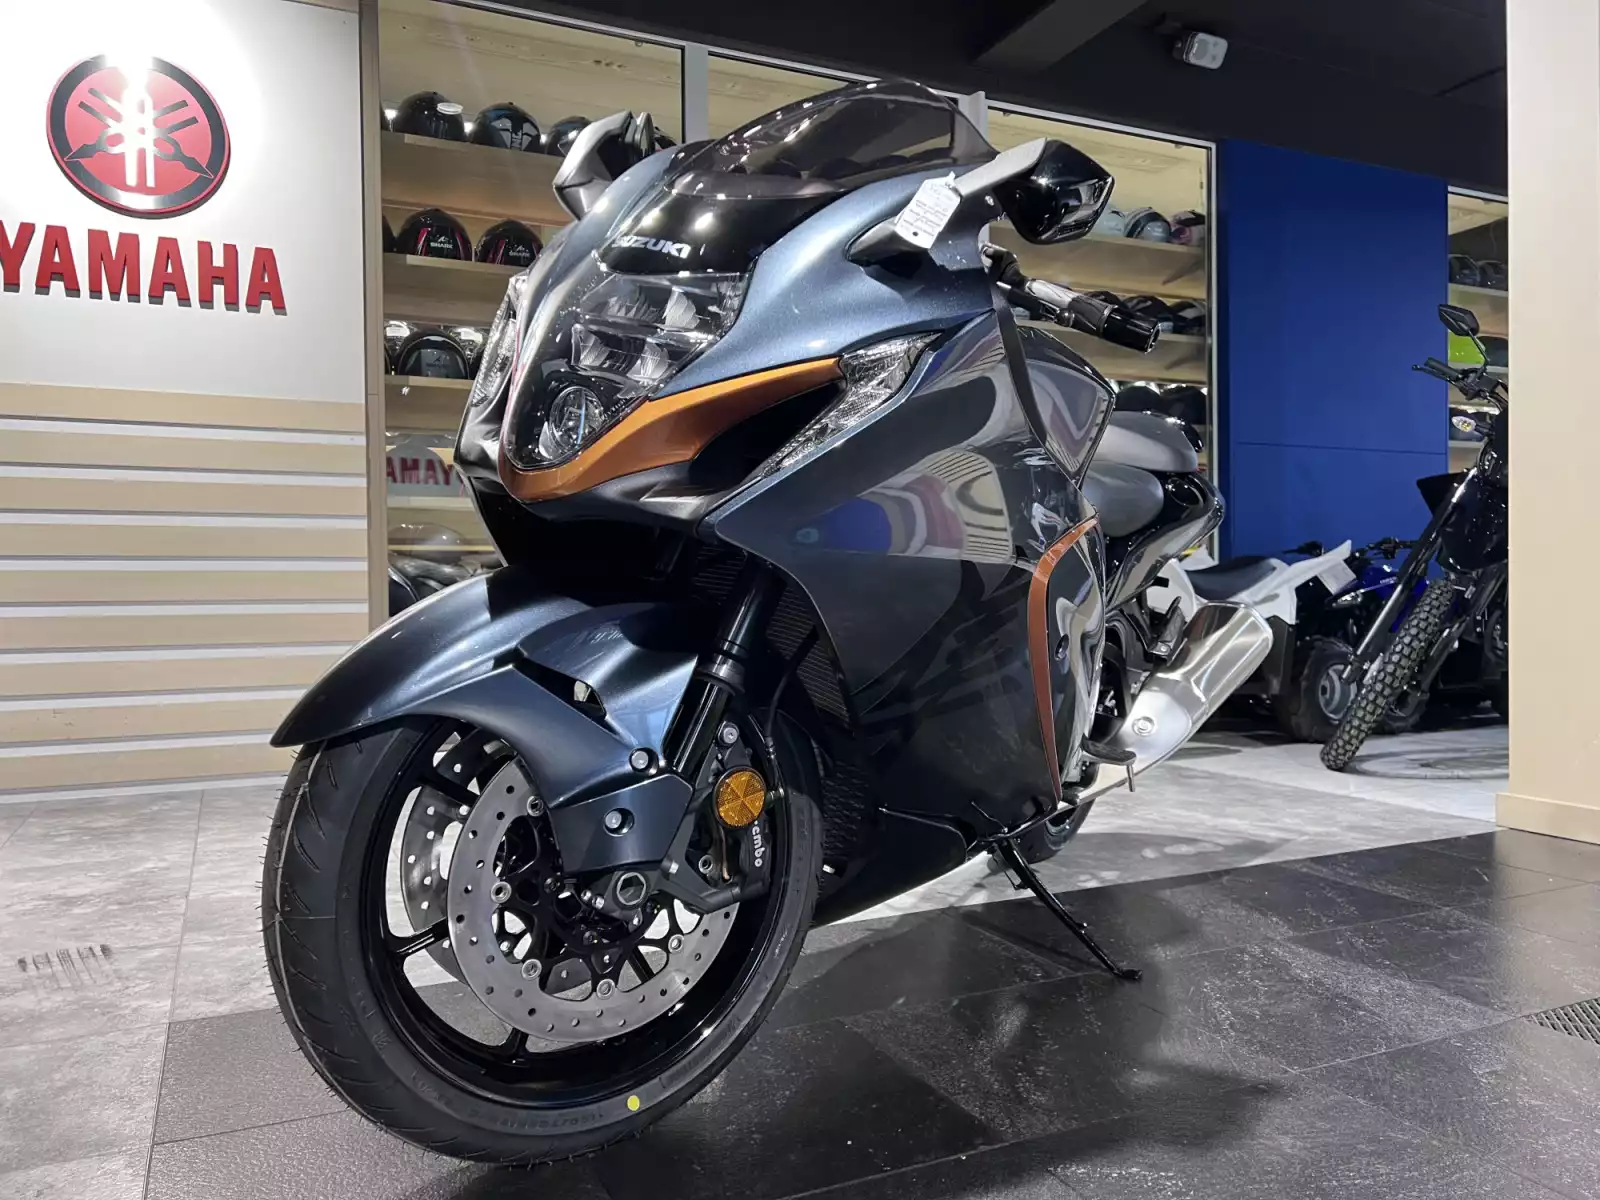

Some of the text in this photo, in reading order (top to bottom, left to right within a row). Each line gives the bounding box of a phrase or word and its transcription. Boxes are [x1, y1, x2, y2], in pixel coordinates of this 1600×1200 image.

[0, 220, 286, 316] YAMAHA
[430, 241, 453, 249] SHARK
[752, 820, 766, 868] embo
